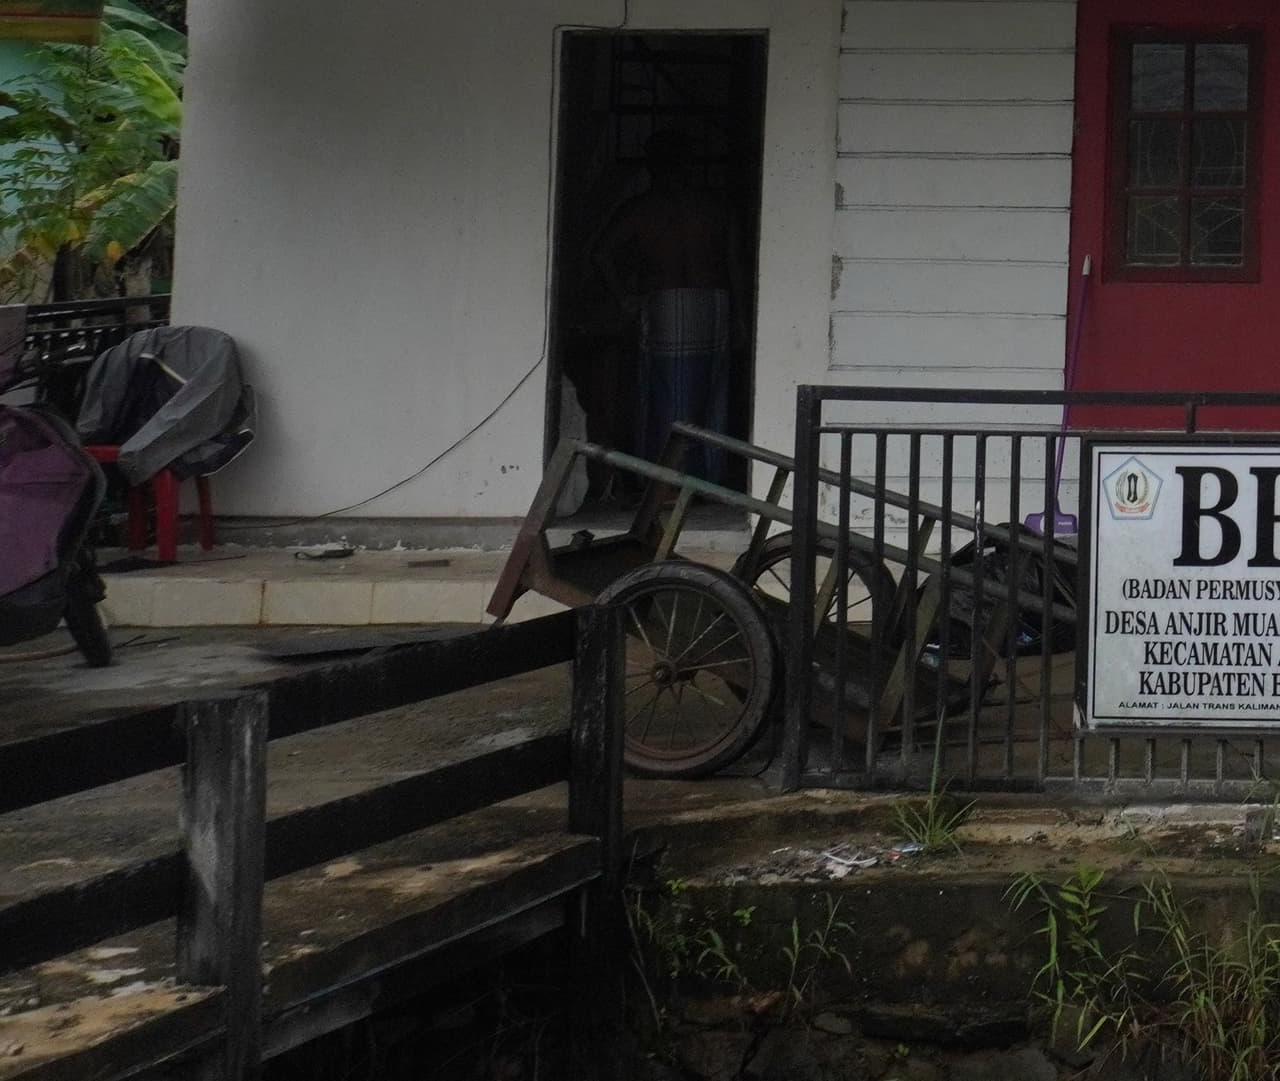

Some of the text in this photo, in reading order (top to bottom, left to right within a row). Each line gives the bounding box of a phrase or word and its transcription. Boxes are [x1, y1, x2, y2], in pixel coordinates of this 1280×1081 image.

[1123, 579, 1191, 600] (BADAN
[1105, 611, 1160, 635] DESA
[1165, 612, 1228, 636] ANJIR
[1144, 641, 1272, 666] KECAMATAN
[1139, 671, 1266, 696] KABUPATEN
